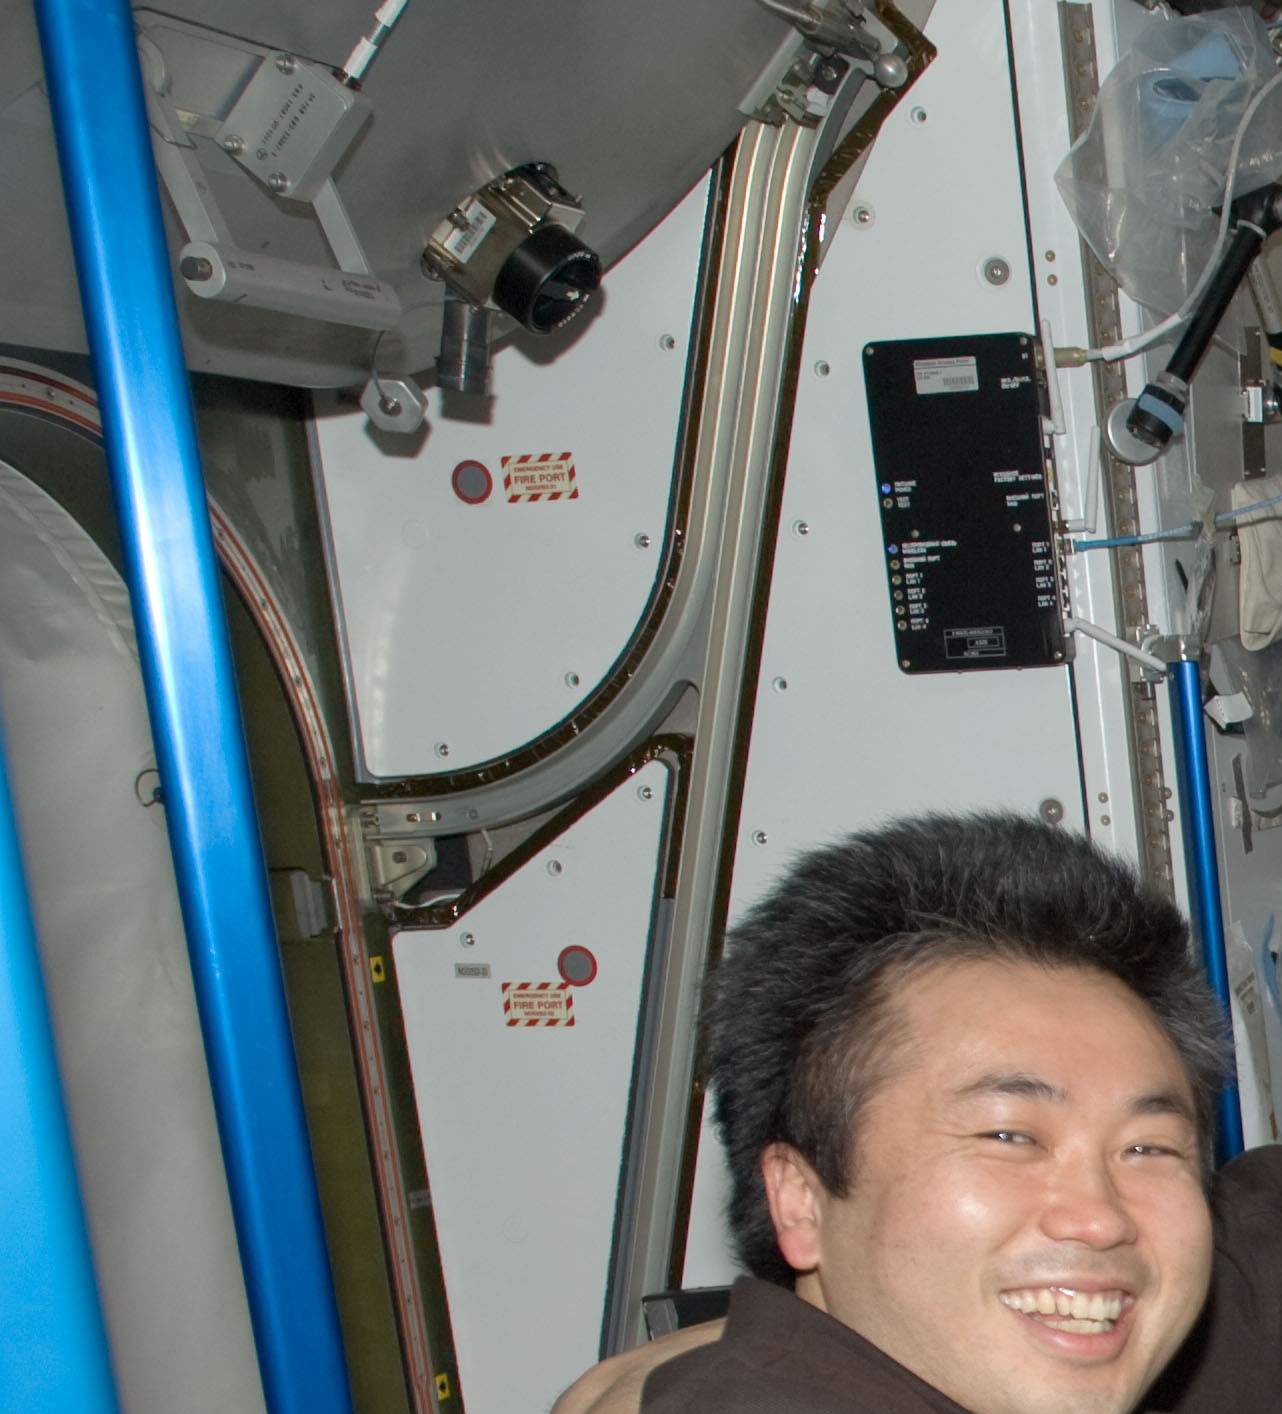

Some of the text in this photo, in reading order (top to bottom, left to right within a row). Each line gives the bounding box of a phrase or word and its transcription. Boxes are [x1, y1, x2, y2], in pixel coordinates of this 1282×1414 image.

[514, 473, 565, 484] FIRE PORT
[513, 1001, 563, 1009] FIRE PORT
